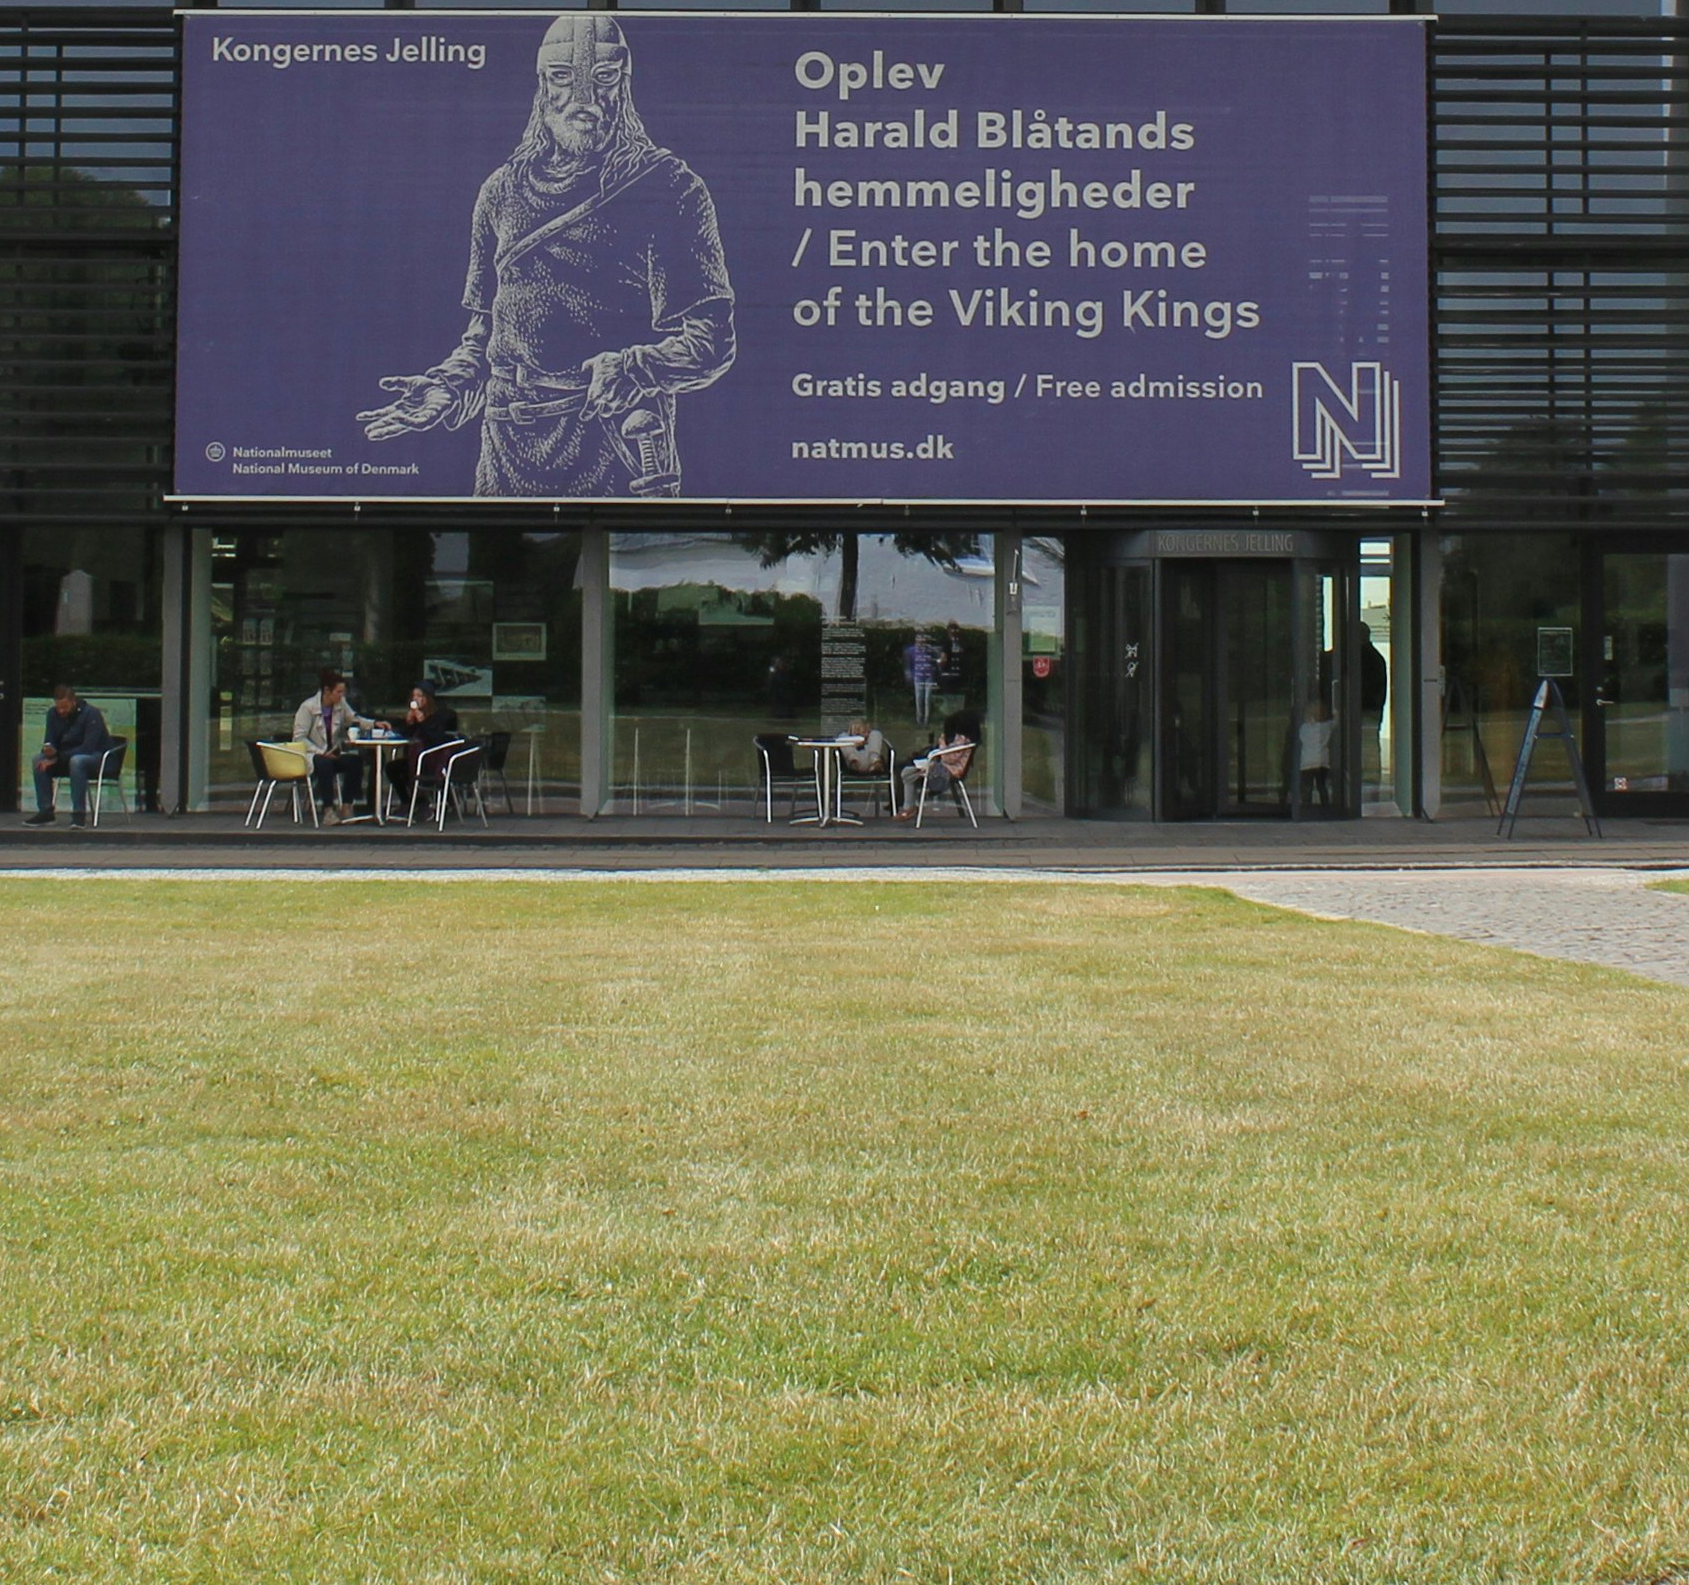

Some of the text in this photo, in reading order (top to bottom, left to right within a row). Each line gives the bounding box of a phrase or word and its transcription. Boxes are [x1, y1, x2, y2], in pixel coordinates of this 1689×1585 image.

[213, 36, 486, 70] Kongernes Jelling
[795, 50, 945, 100] Oplev
[796, 109, 1195, 150] Harald Blåtands
[795, 167, 1195, 219] hemmeligheder
[791, 227, 1207, 268] / Enter the home
[793, 286, 1260, 339] of the Viking Kings
[792, 372, 1263, 402] Gratis adgang / Free admission
[233, 446, 332, 459] Nationalmuseet
[792, 434, 954, 459] natmus.dk
[232, 462, 420, 475] National Museum of Denmark
[1244, 533, 1294, 552] JELLING
